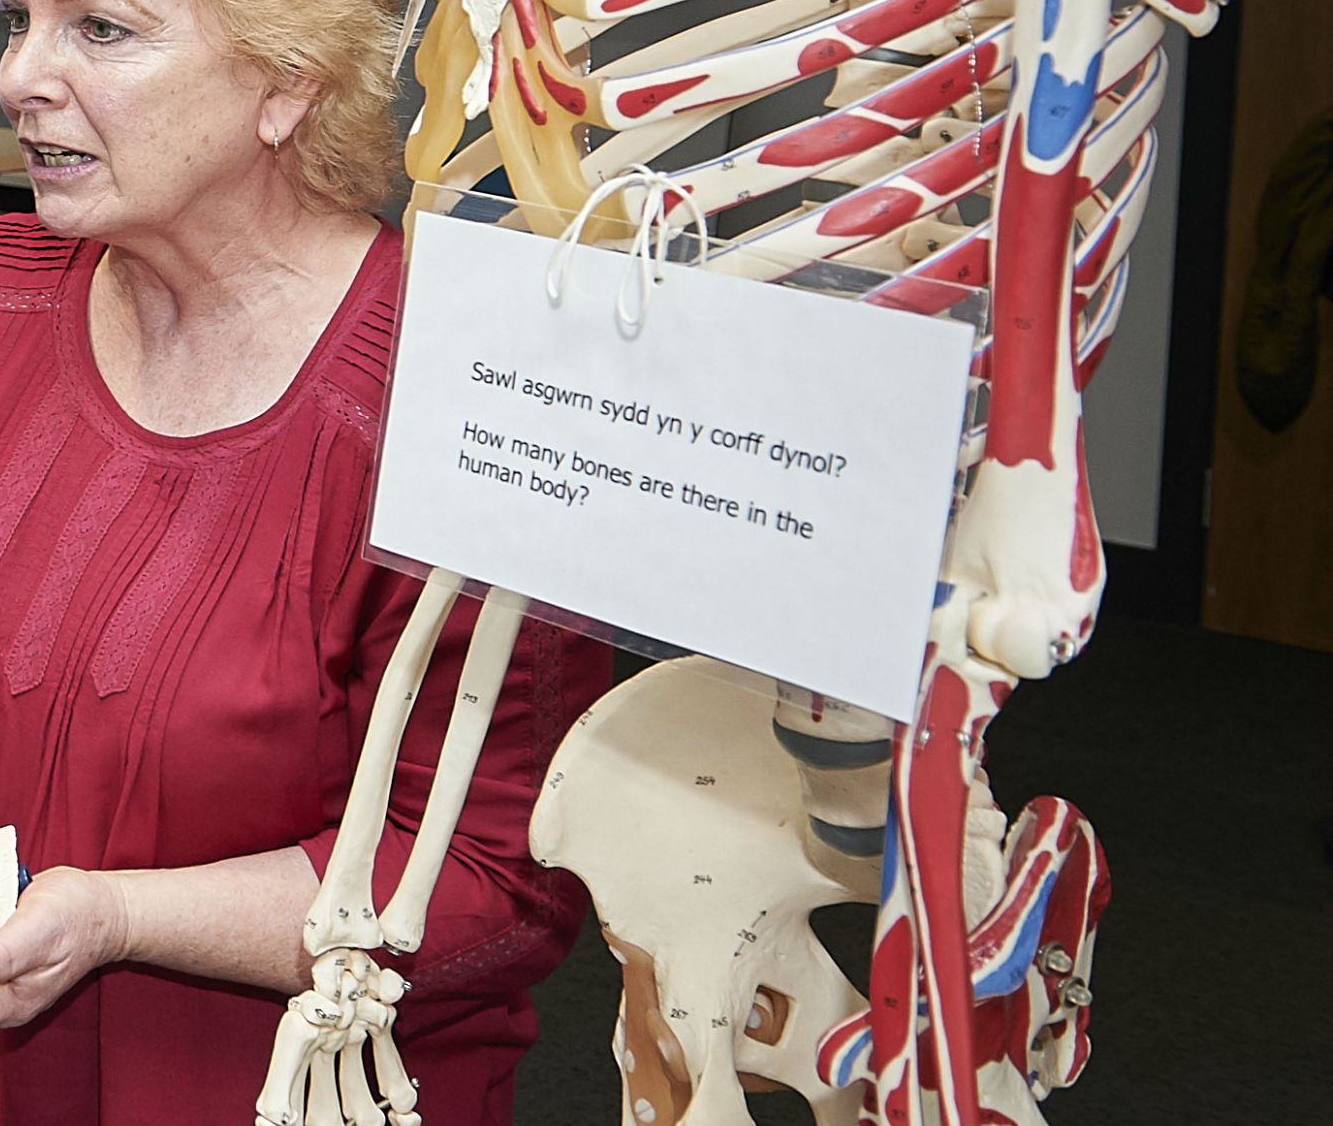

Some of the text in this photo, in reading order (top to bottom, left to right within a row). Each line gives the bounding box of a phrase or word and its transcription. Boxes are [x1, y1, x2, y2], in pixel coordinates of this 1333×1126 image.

[471, 362, 848, 478] Sawl asgwrn sydd yn y corff dynol?
[458, 450, 590, 507] human body?
[463, 421, 814, 540] How many bones are there in the
[693, 874, 713, 886] 244
